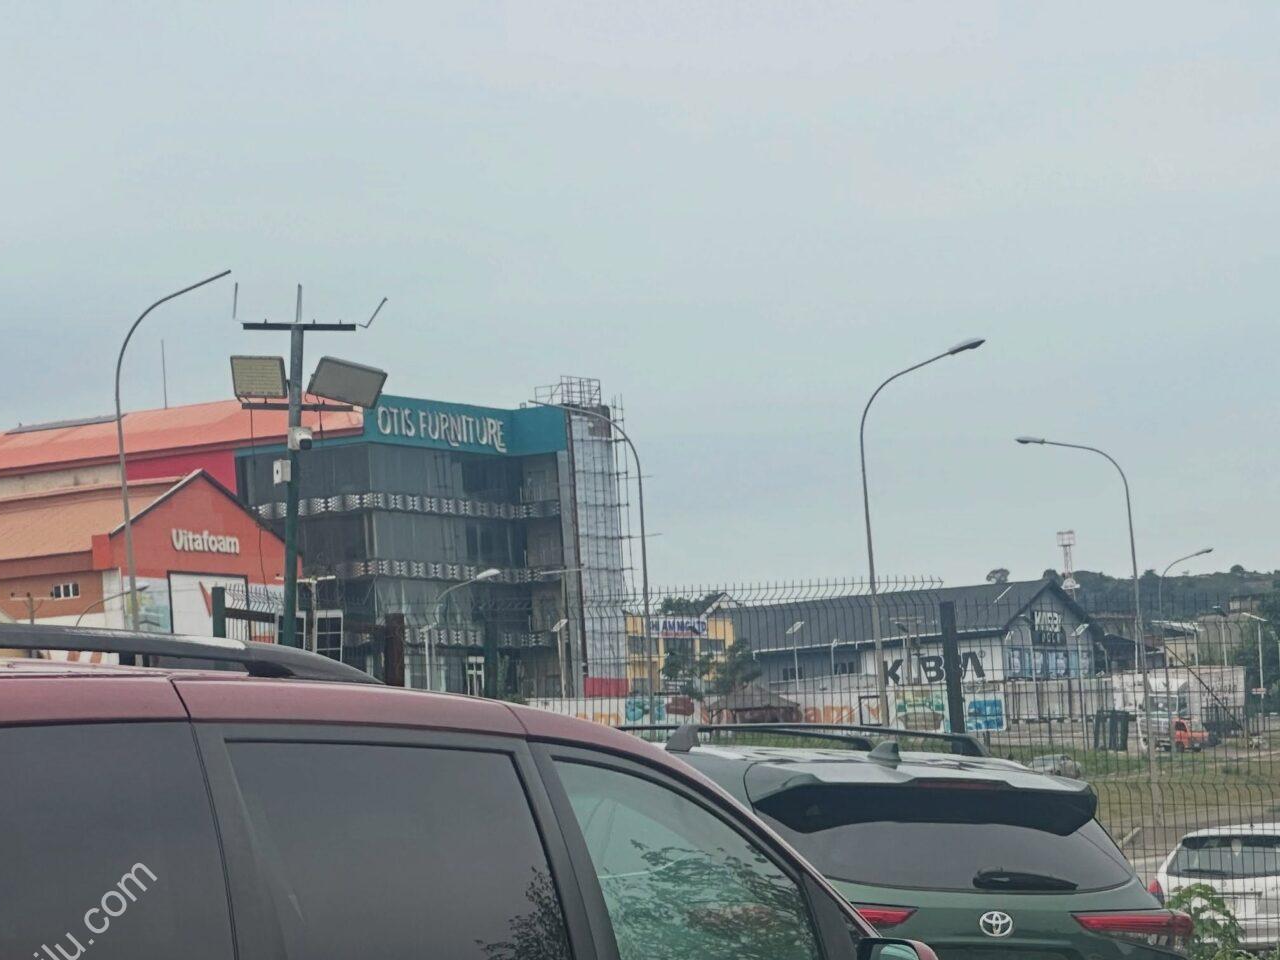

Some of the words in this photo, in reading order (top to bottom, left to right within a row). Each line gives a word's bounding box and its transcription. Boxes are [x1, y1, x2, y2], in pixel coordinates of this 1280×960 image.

[377, 406, 416, 437] OTIS
[418, 410, 507, 453] FURNITURE
[171, 528, 240, 555] Vitafoam
